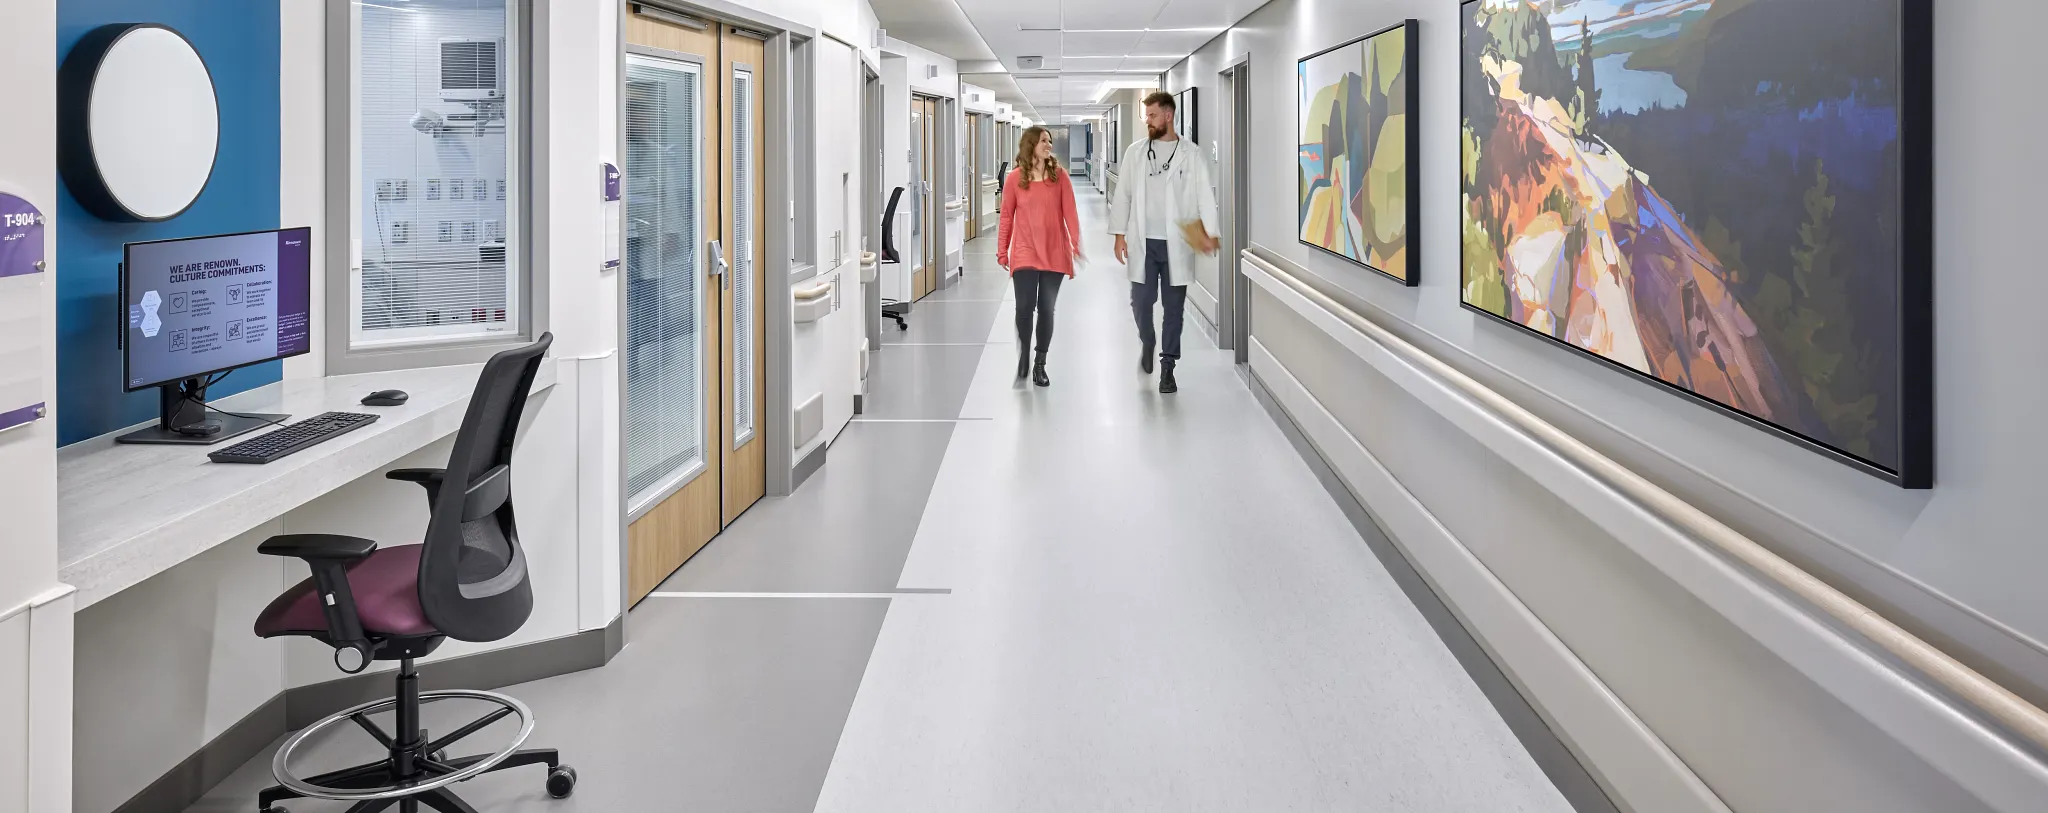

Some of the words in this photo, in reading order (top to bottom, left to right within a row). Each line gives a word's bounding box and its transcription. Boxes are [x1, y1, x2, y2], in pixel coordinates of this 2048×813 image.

[4, 212, 35, 228] T-904
[169, 265, 184, 274] WE
[185, 262, 202, 273] ARE
[203, 258, 241, 270] RENOWN.
[169, 271, 207, 284] CULTURE
[207, 264, 266, 279] COMMITMENTS:
